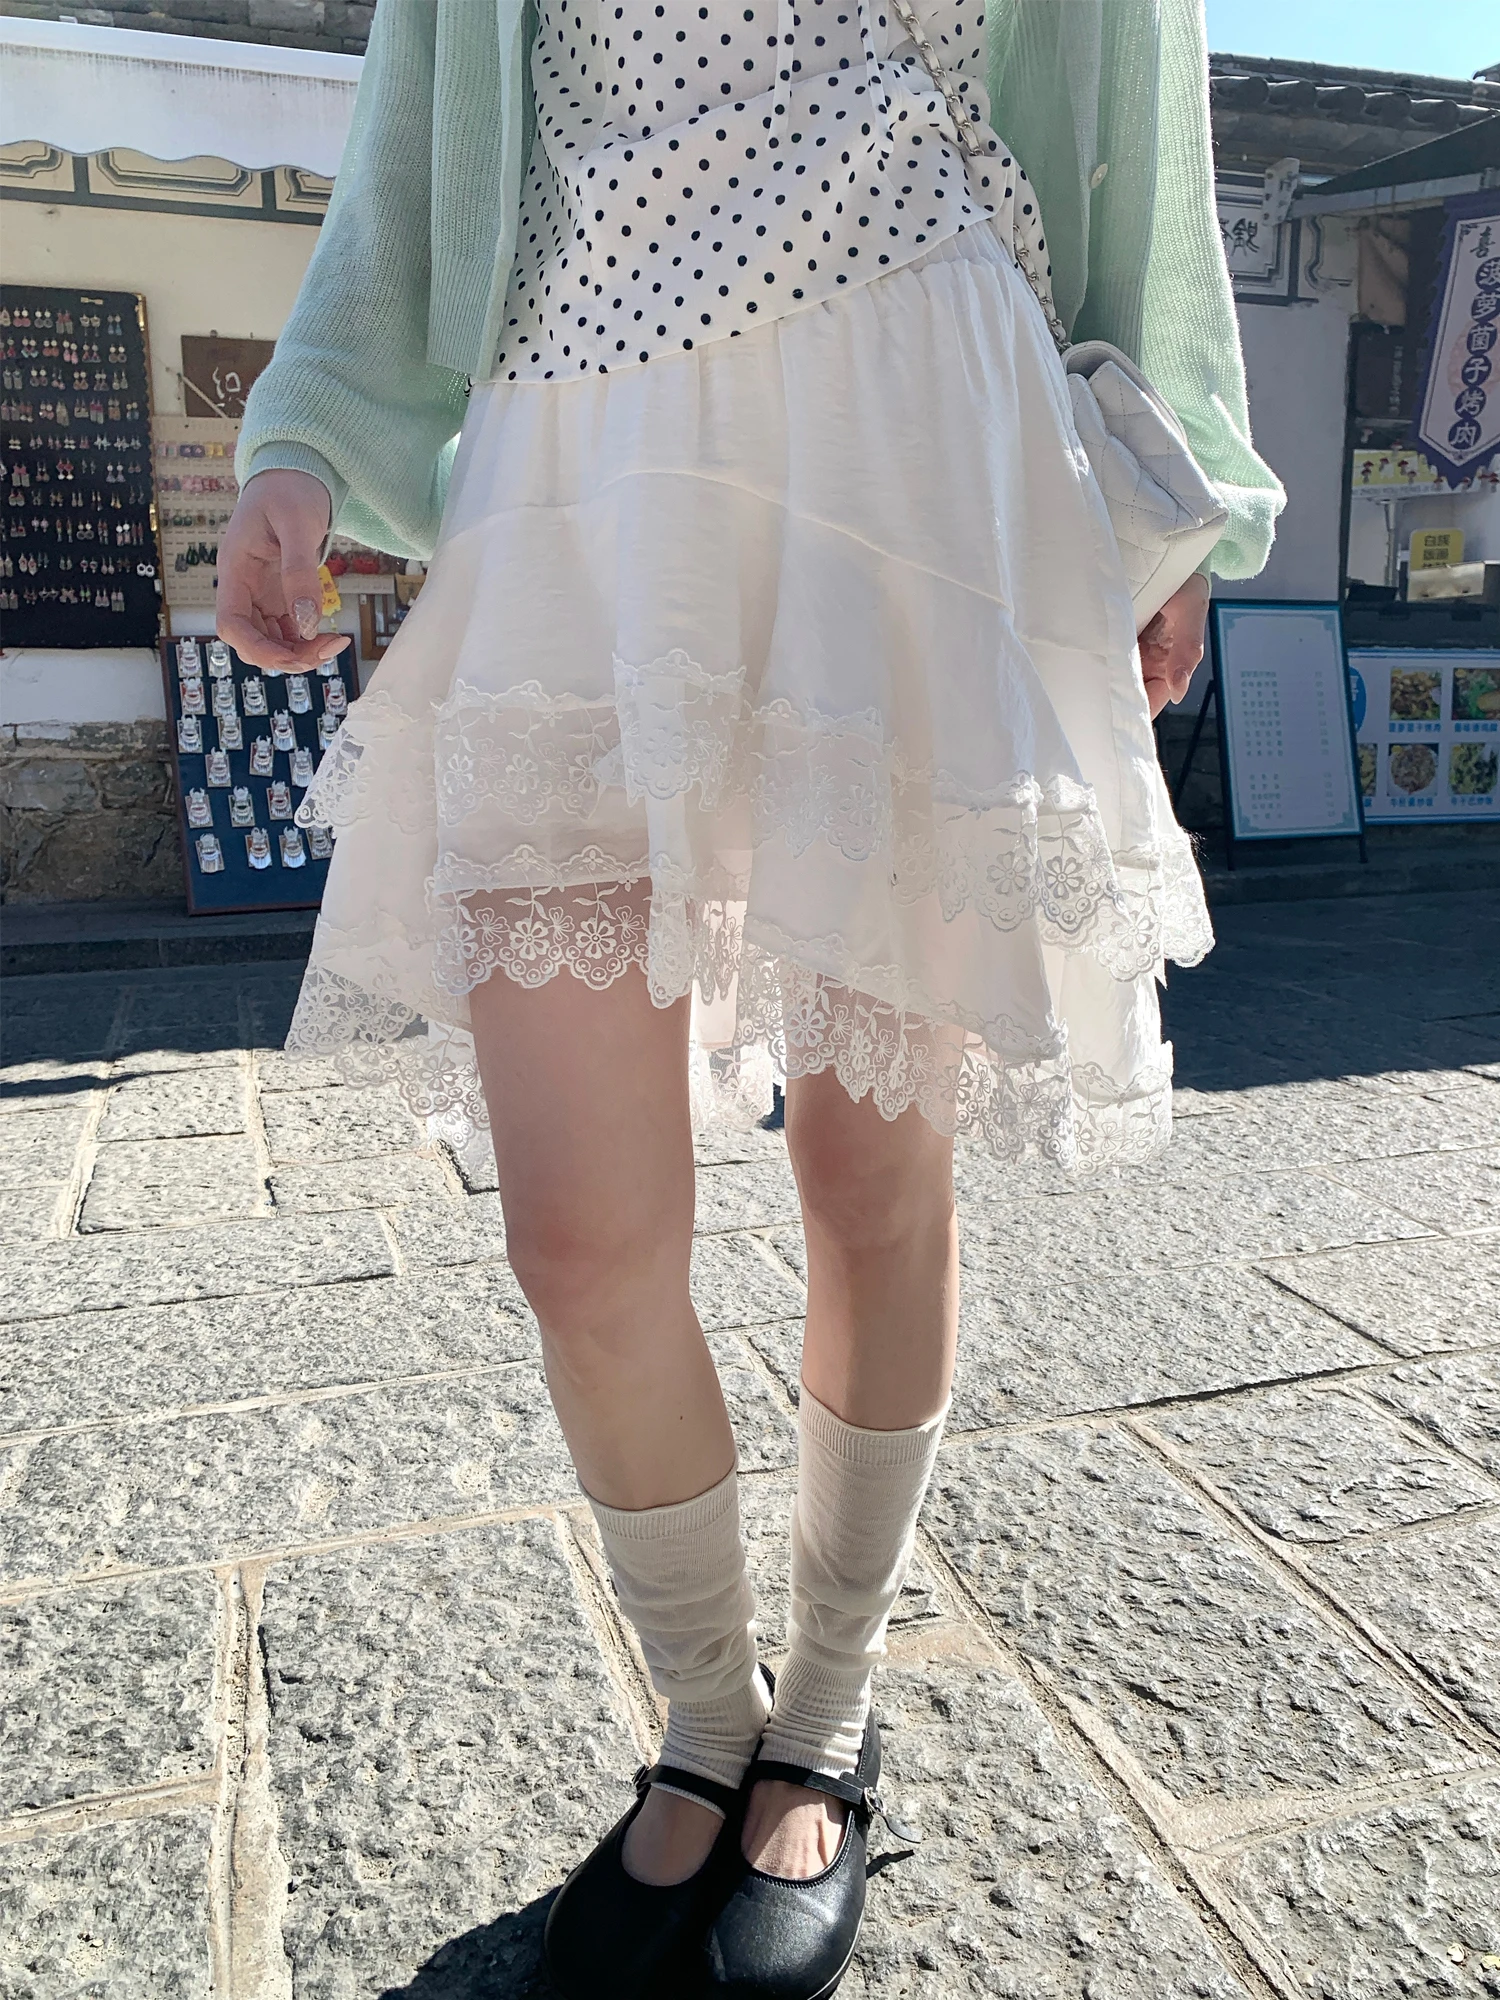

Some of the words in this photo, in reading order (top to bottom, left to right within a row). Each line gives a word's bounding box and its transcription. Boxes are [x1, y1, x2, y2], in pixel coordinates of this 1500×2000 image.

[1450, 261, 1500, 447] 菠萝菌子烤肉
